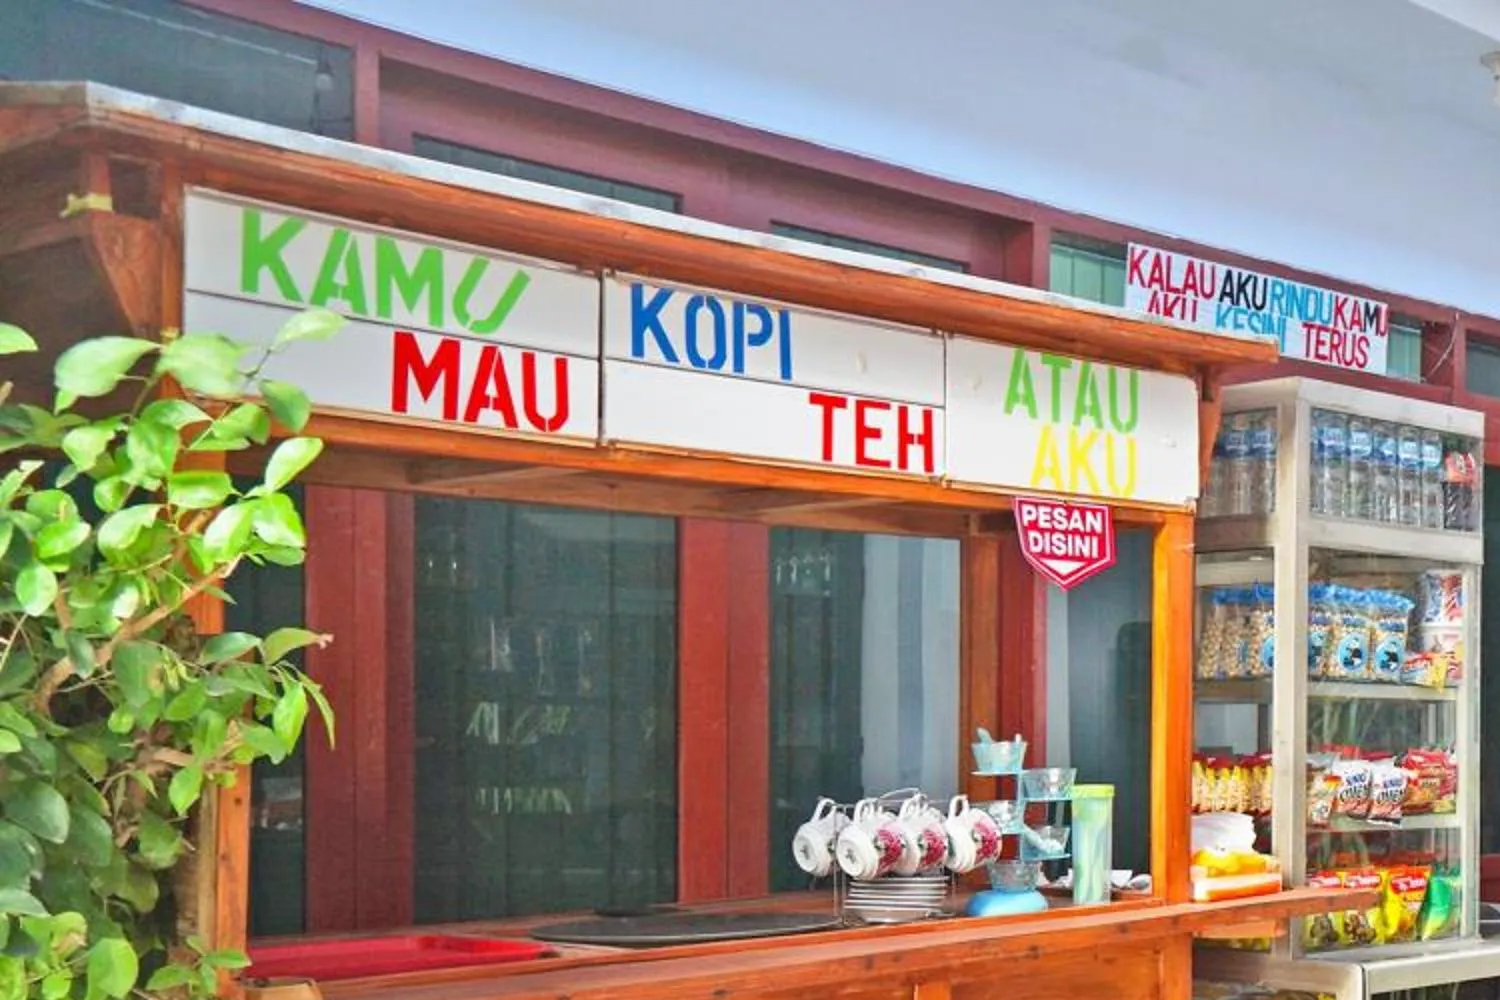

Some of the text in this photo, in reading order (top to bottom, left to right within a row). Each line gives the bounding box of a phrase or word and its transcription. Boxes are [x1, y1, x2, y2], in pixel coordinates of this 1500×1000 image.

[240, 208, 531, 334] KAMU
[1129, 247, 1217, 299] KALAU
[1219, 269, 1268, 311] AKU
[1270, 279, 1333, 325] RINDU
[630, 282, 793, 381] KOPI
[1302, 323, 1370, 369] TERUS
[391, 331, 570, 433] MAU
[1003, 347, 1139, 434] ATAU
[809, 392, 935, 473] TEH
[1029, 424, 1137, 496] AKU
[1021, 504, 1103, 534] PESAN
[1028, 530, 1099, 558] DISINI
